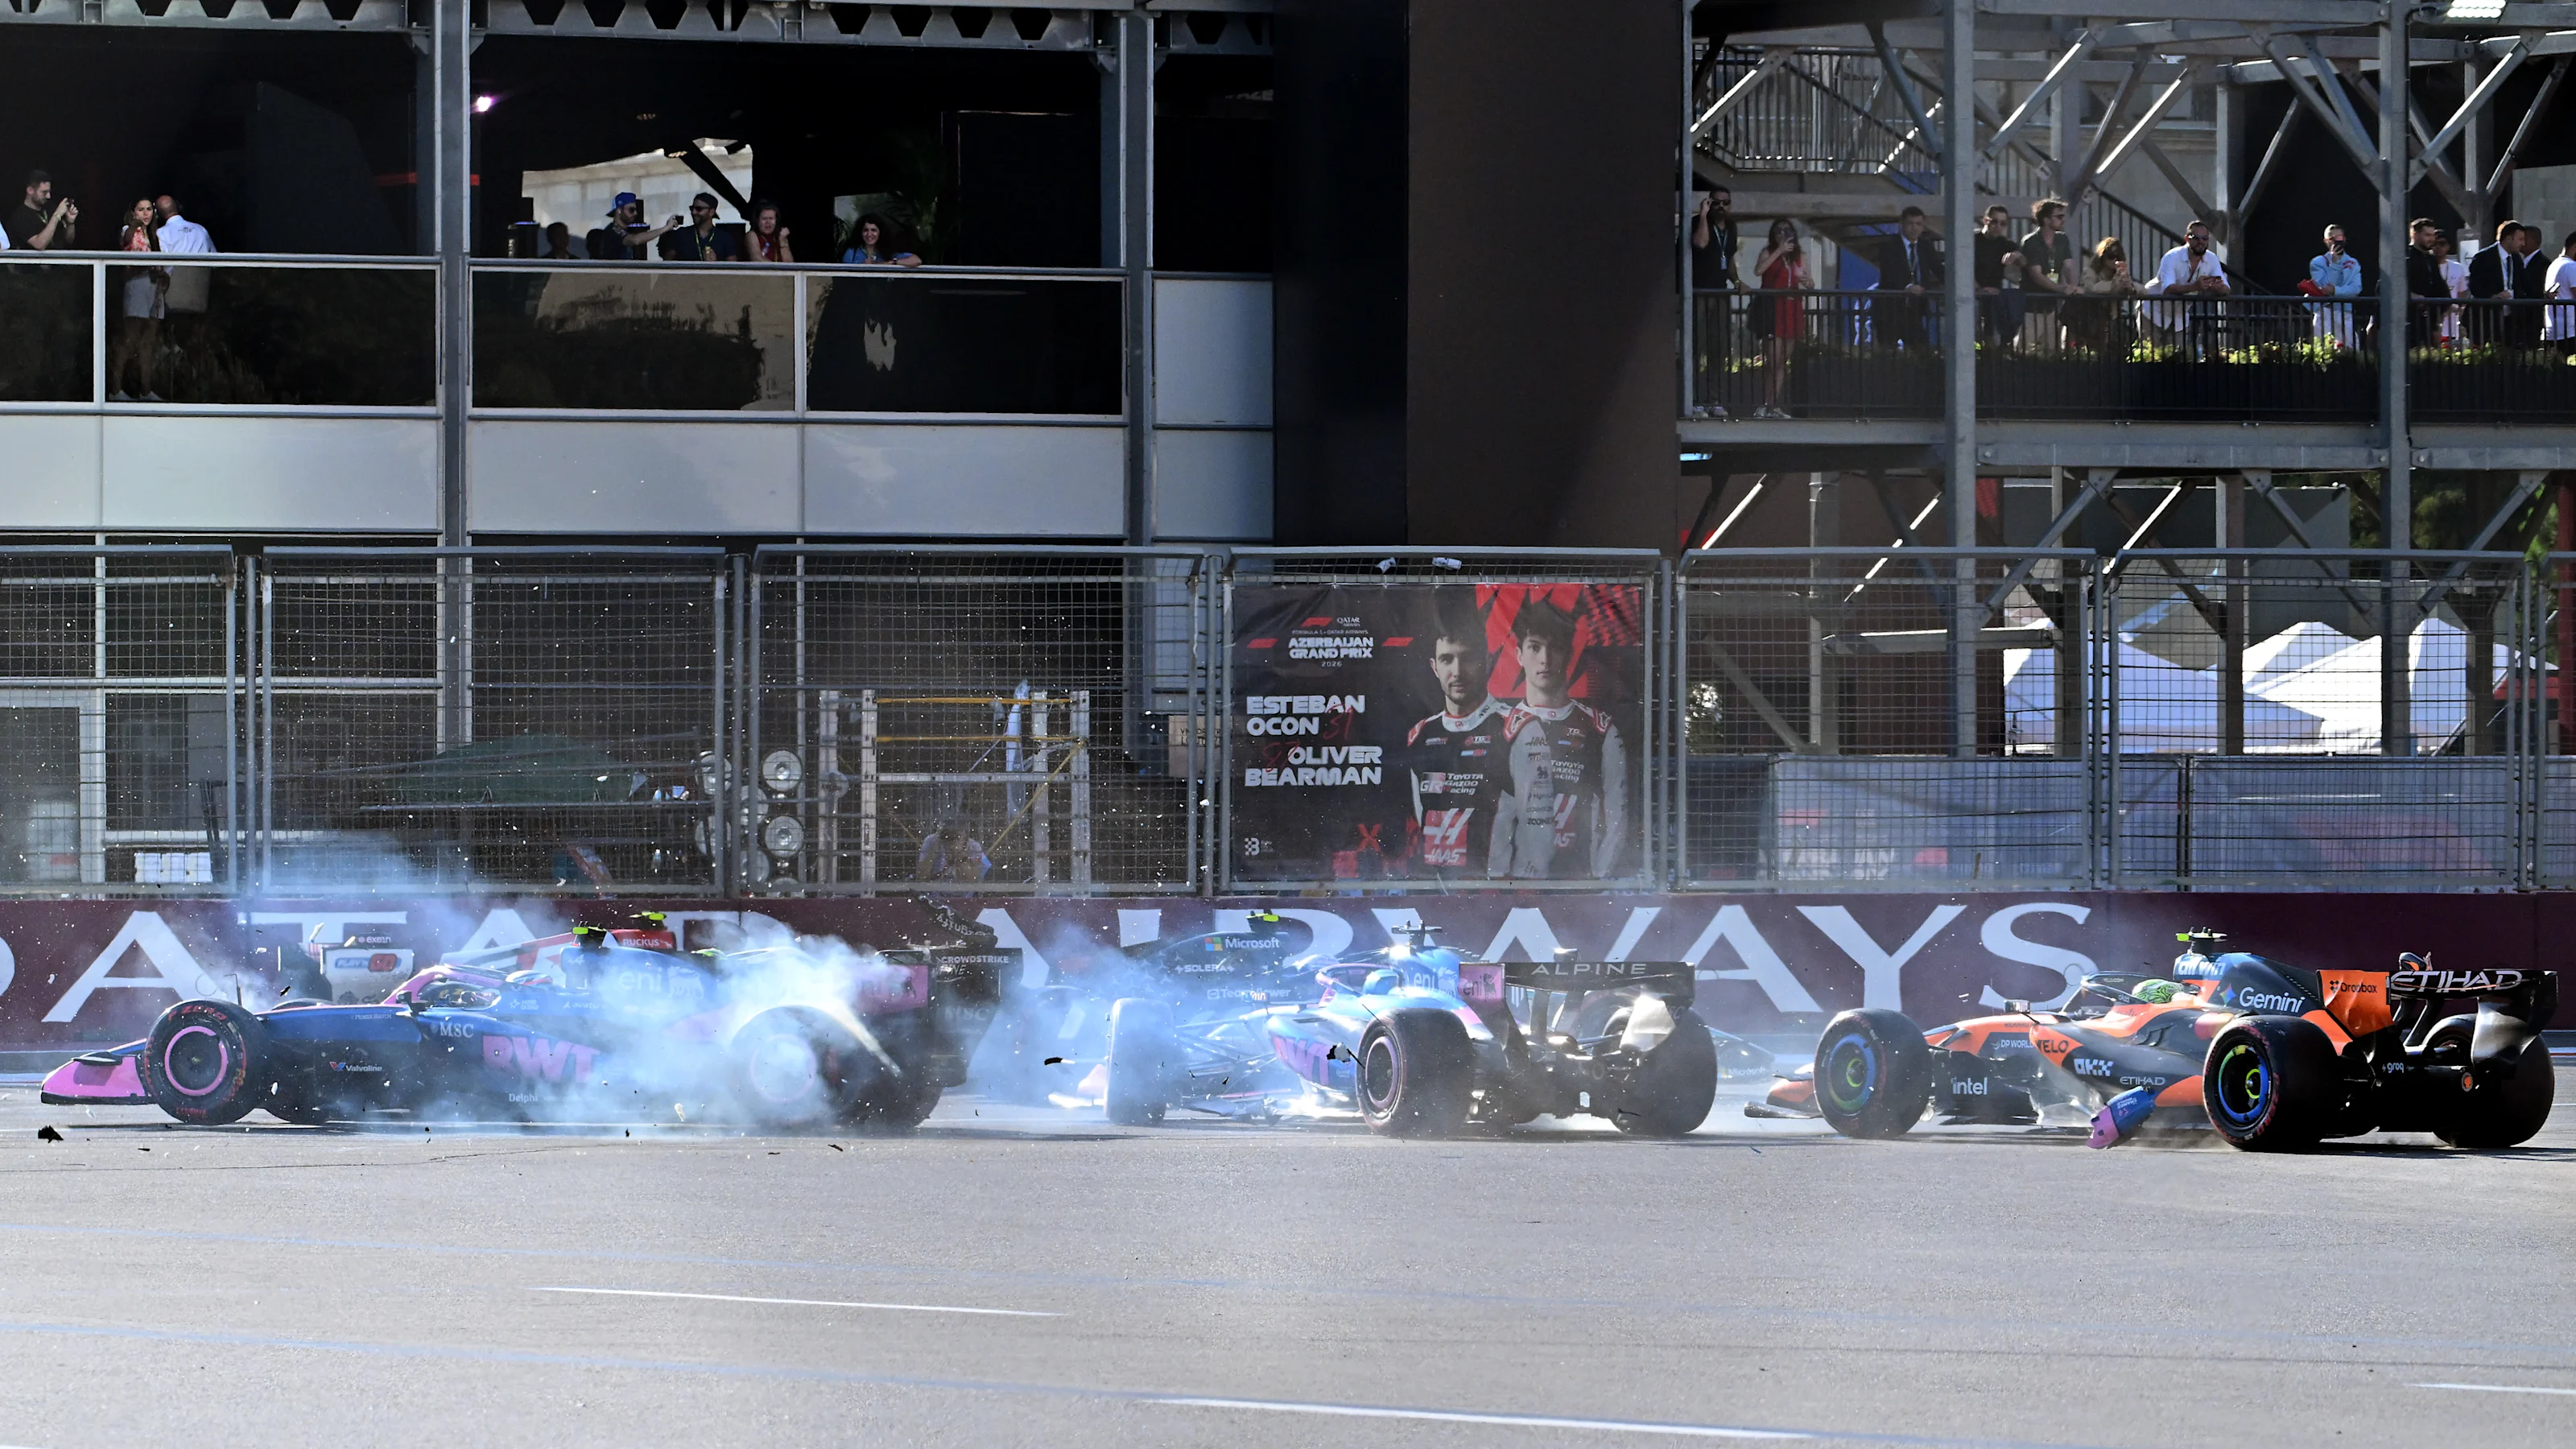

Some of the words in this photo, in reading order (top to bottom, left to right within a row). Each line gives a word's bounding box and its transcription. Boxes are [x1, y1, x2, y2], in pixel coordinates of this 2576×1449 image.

[1289, 637, 1374, 649] AZERBAIJAN
[1289, 648, 1339, 659] GRAND
[1340, 647, 1373, 658] PRIX
[1246, 695, 1366, 715] ESTEBAN
[1246, 716, 1320, 737] OCON
[1288, 745, 1383, 765] OLIVER
[1245, 766, 1382, 786] BEARMAN
[623, 938, 660, 946] RUCKUS
[1225, 937, 1281, 948] Microsoft
[940, 956, 1009, 964] CROWDSTRIKE
[1184, 964, 1228, 972] SOLERA
[1531, 963, 1647, 976] ALPINE
[619, 968, 662, 991] eni
[1414, 972, 1437, 990] eni
[1463, 975, 1482, 997] eni
[2390, 970, 2523, 993] ETIHAD
[2340, 981, 2377, 994] Dropbox
[2239, 986, 2306, 1013] Gemini
[440, 1022, 474, 1038] MSC
[2000, 1039, 2010, 1048] DP
[2035, 1039, 2070, 1054] VELO
[345, 1064, 383, 1072] Valvoline
[2074, 1058, 2115, 1077] OKX
[2387, 1063, 2405, 1074] groq
[1951, 1075, 1988, 1095] intel
[2120, 1076, 2165, 1086] ETIHAD
[509, 1093, 538, 1104] Delphi
